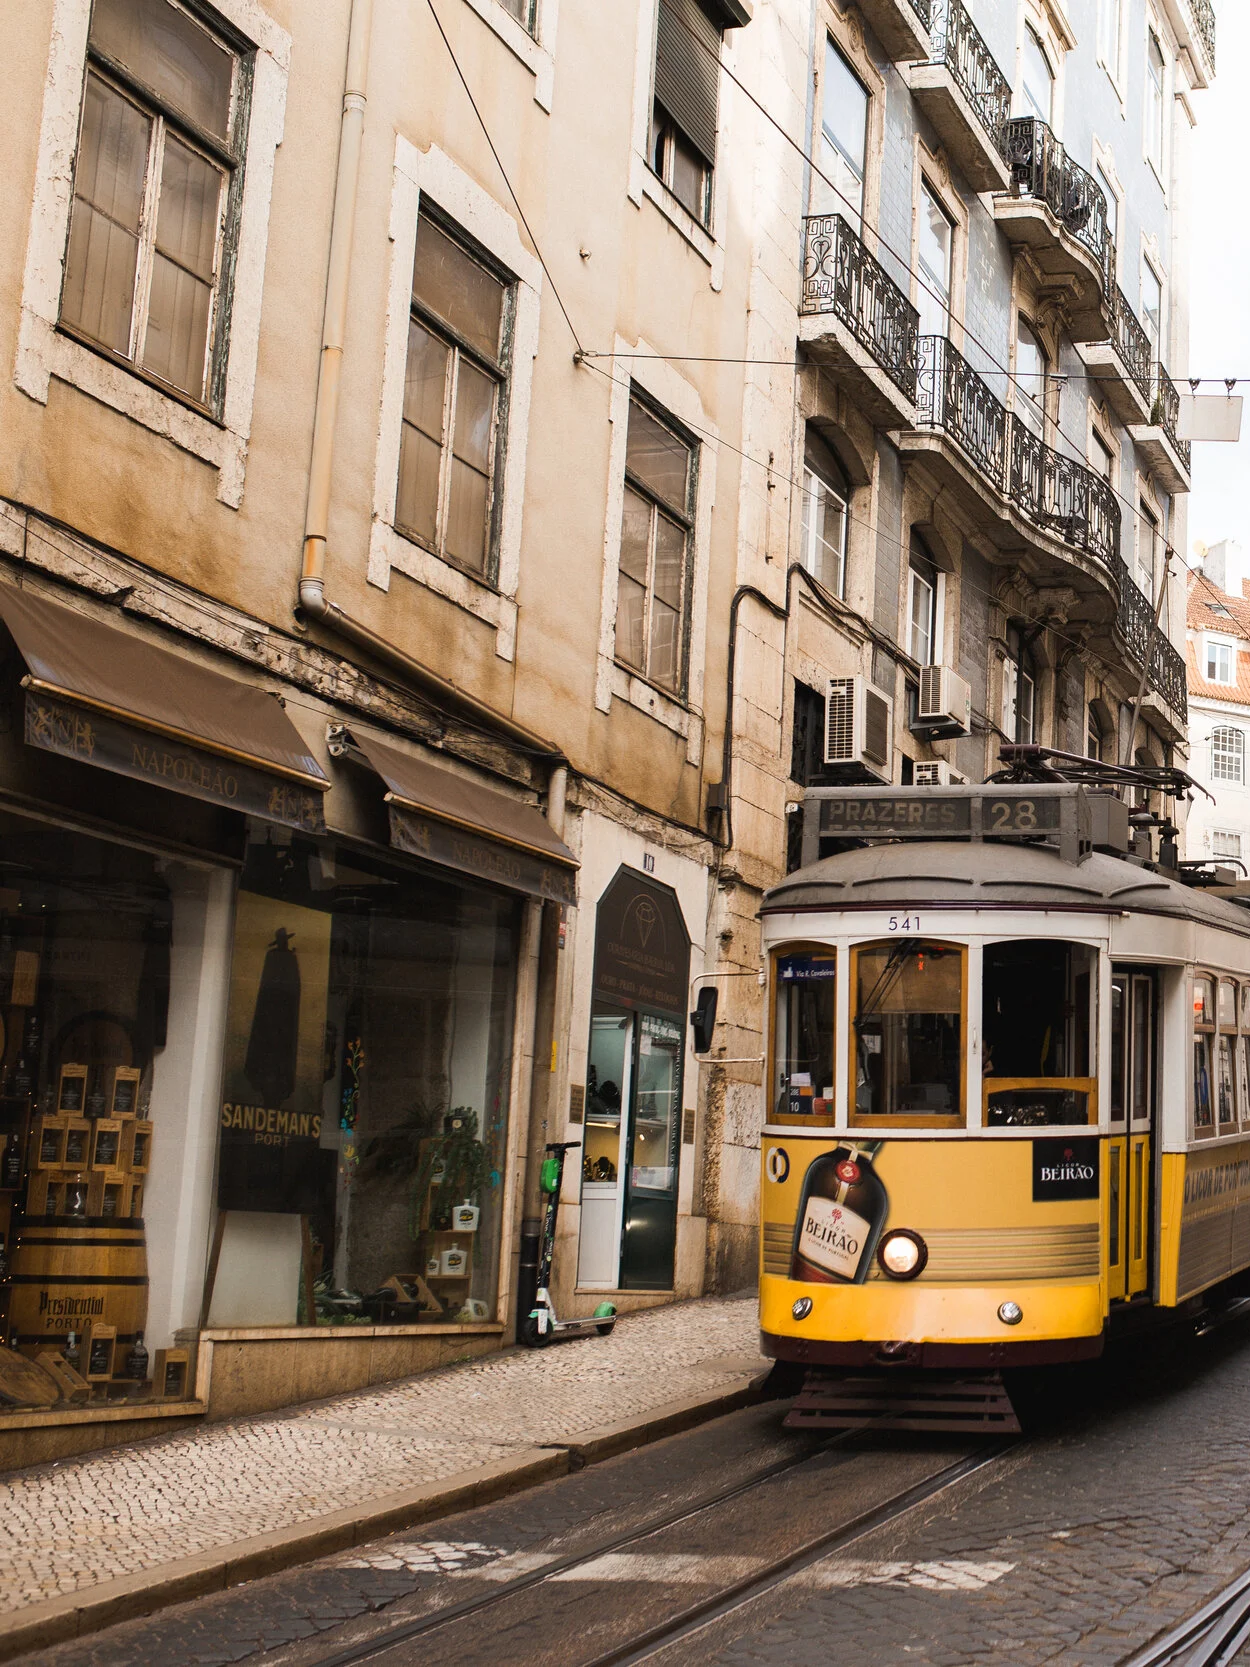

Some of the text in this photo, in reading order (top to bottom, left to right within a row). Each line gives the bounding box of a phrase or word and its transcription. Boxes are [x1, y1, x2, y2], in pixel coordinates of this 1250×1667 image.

[131, 743, 239, 799] NAPOLEÃO
[829, 800, 1038, 830] PRAZERES 28
[645, 855, 654, 871] 10
[888, 916, 920, 931] 541
[790, 1101, 800, 1112] 10
[221, 1102, 321, 1138] SANDEMAN'S
[254, 1132, 291, 1147] PORT
[1040, 1165, 1094, 1181] BEIRÃO
[1191, 1168, 1213, 1202] LICOR
[1213, 1165, 1224, 1196] DE
[805, 1216, 858, 1255] BEIRÃO
[39, 1291, 104, 1316] Presidential
[46, 1317, 92, 1329] PORTO
